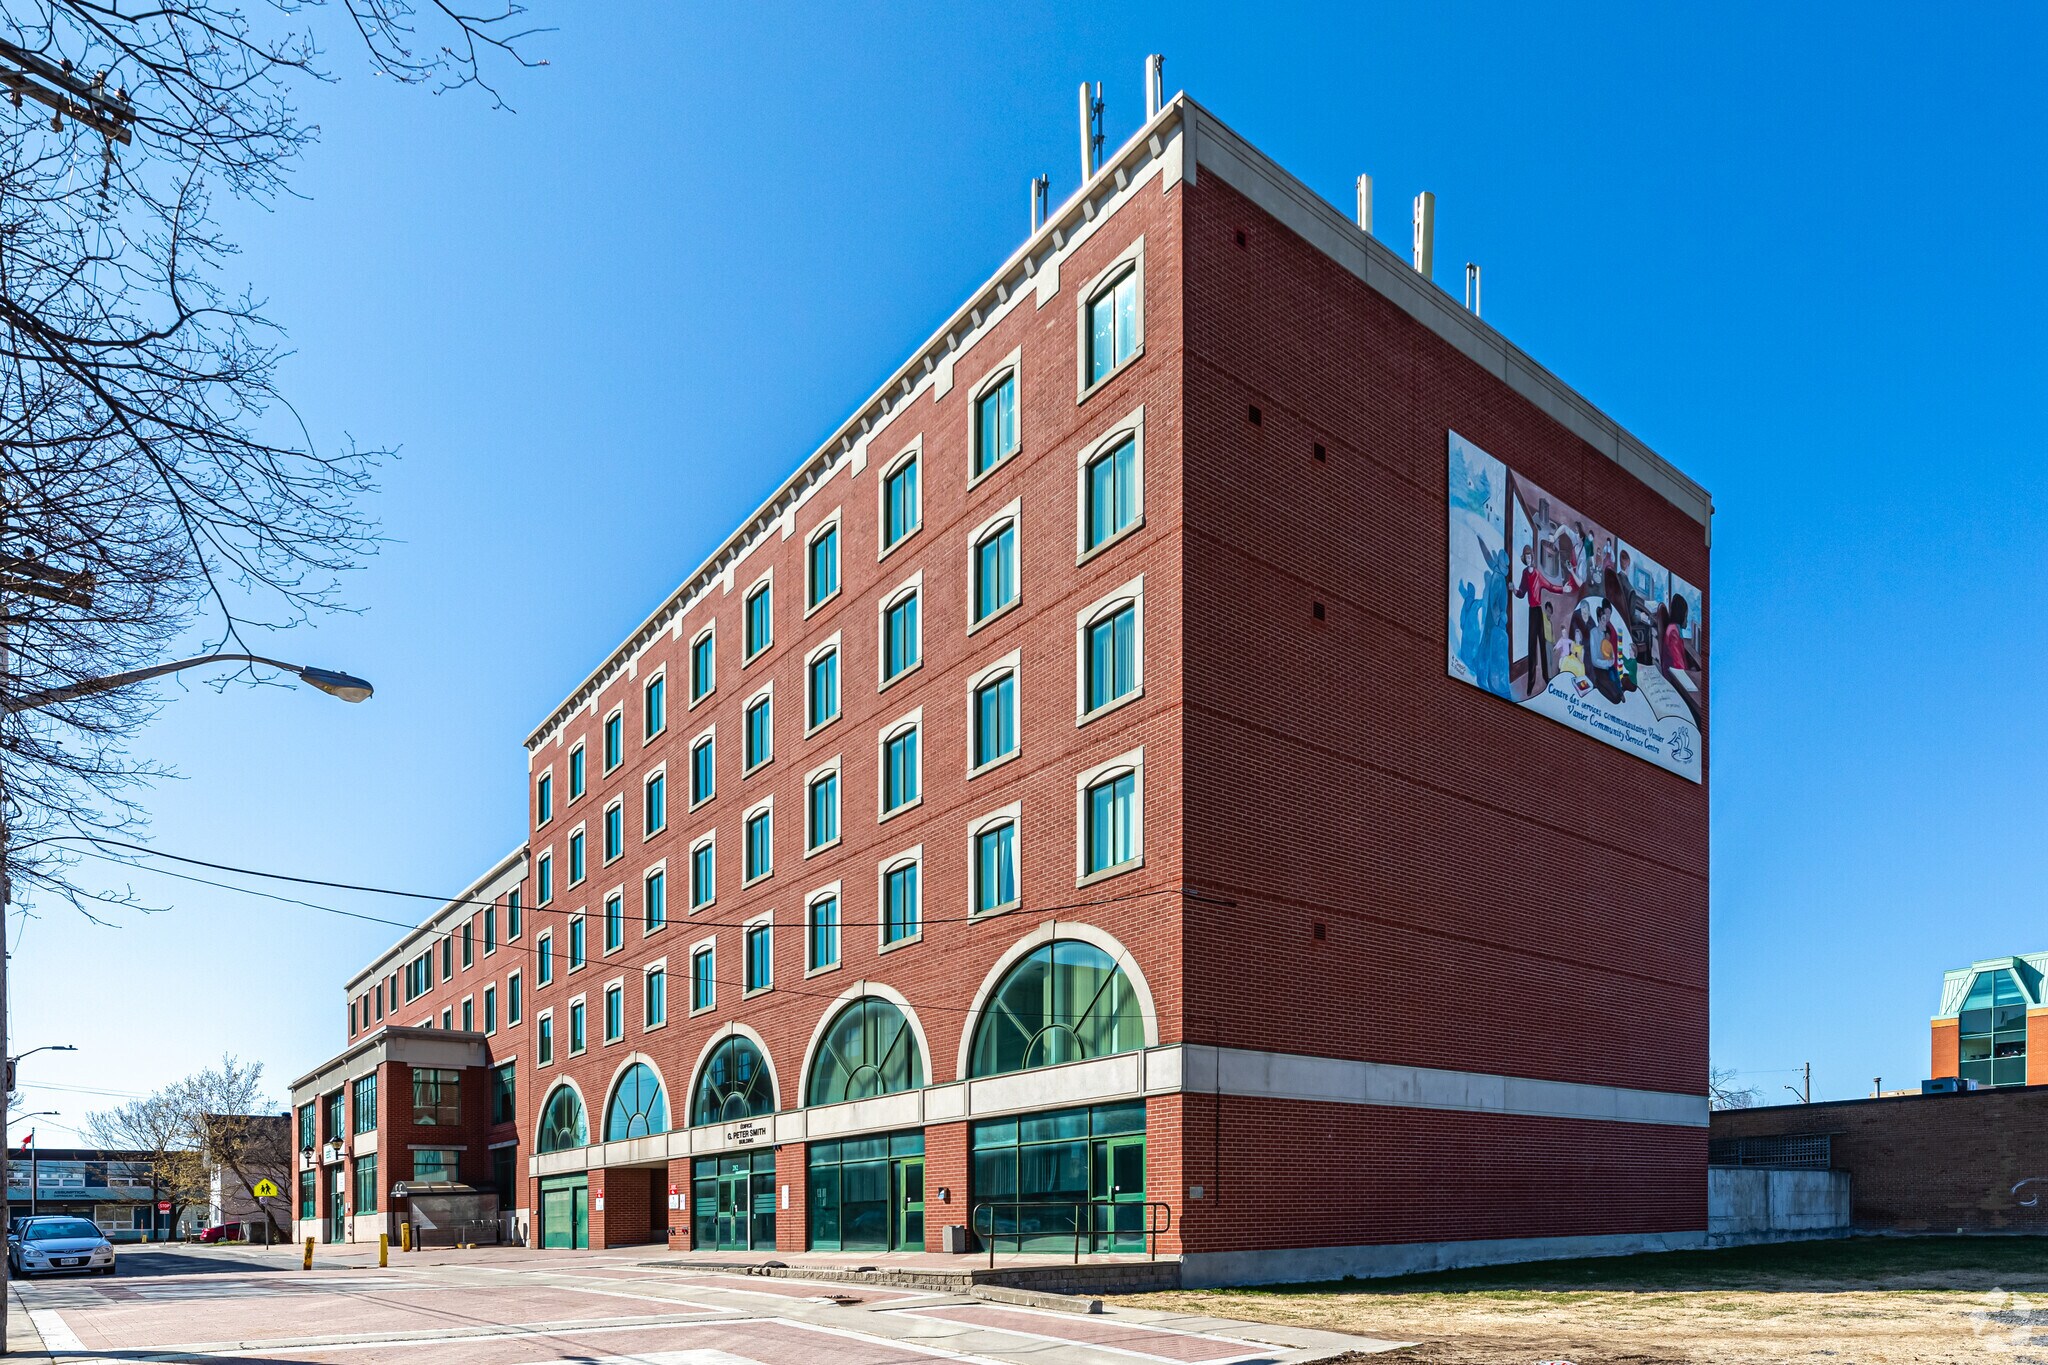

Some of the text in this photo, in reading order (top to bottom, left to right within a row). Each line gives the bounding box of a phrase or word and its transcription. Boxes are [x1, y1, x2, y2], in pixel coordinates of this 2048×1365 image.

[1548, 683, 1665, 743] Centre des services communautaires Vanier
[1567, 704, 1660, 754] Vanier Community Service Centre
[727, 1127, 766, 1140] G. PETER SMITH
